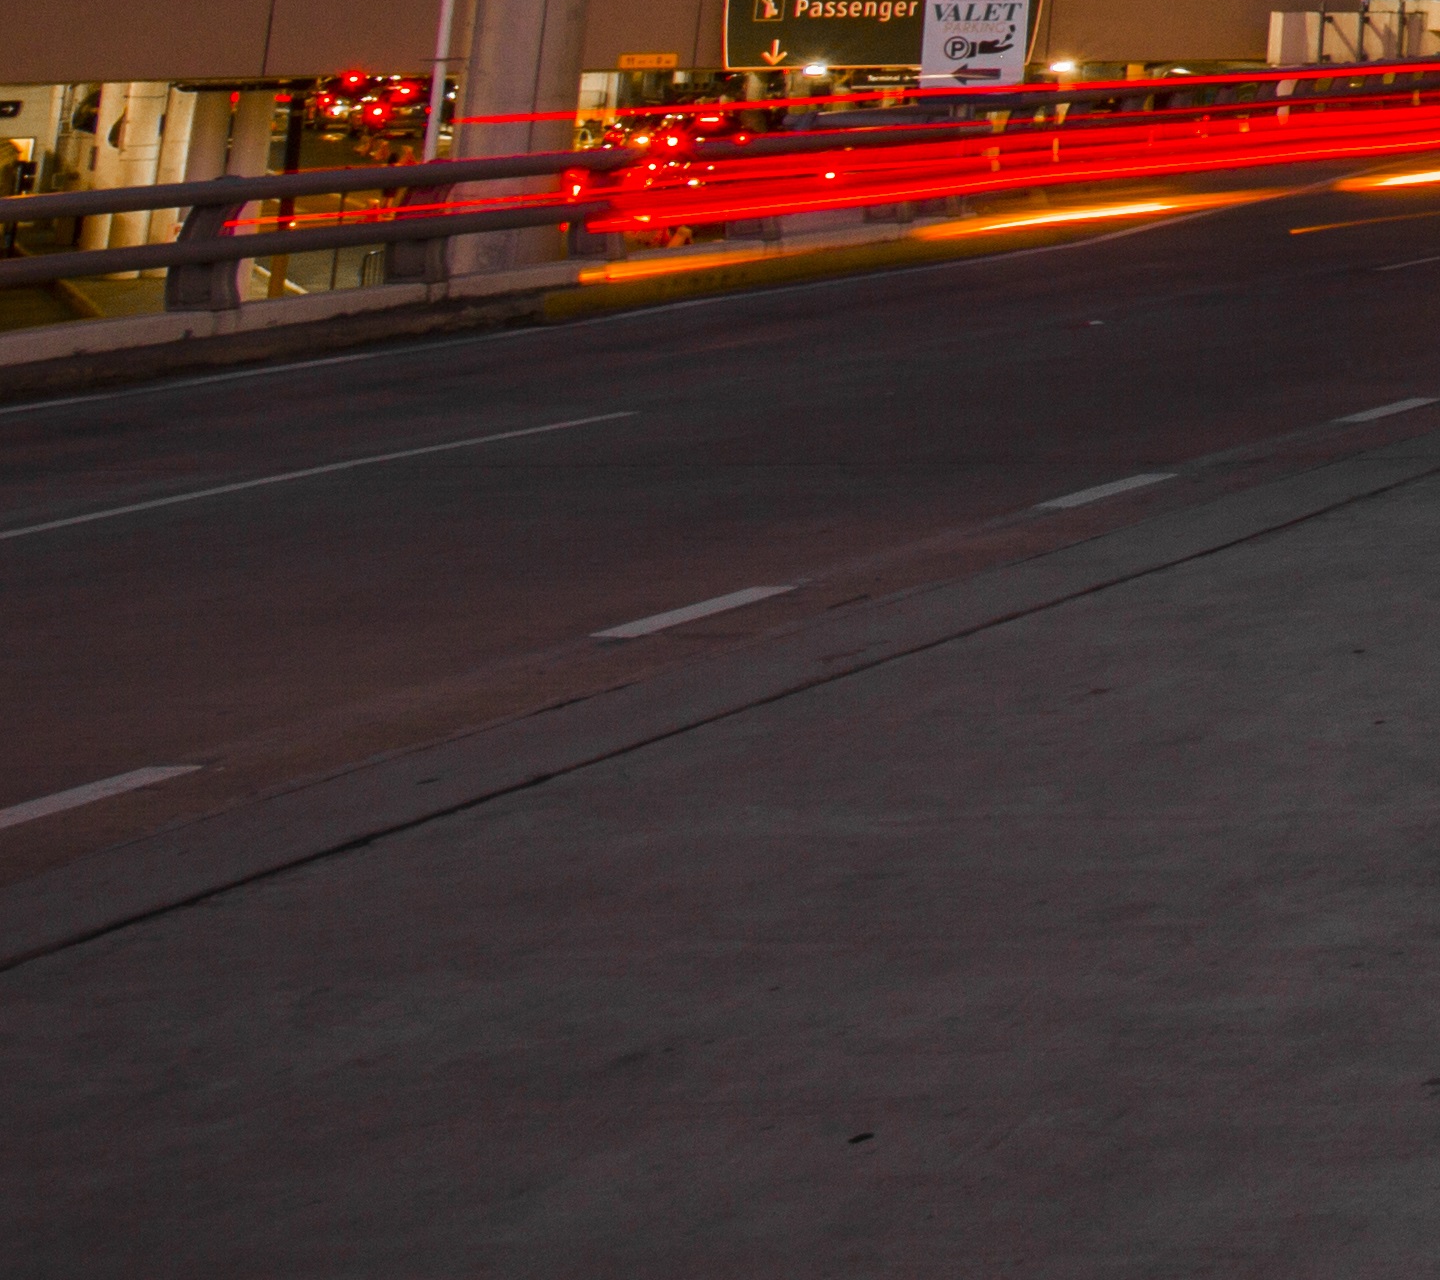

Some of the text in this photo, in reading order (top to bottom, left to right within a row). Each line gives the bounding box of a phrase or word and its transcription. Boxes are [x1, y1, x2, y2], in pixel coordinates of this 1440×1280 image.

[933, 3, 1023, 22] VALET
[943, 21, 1006, 34] PARKING
[950, 40, 965, 57] P
